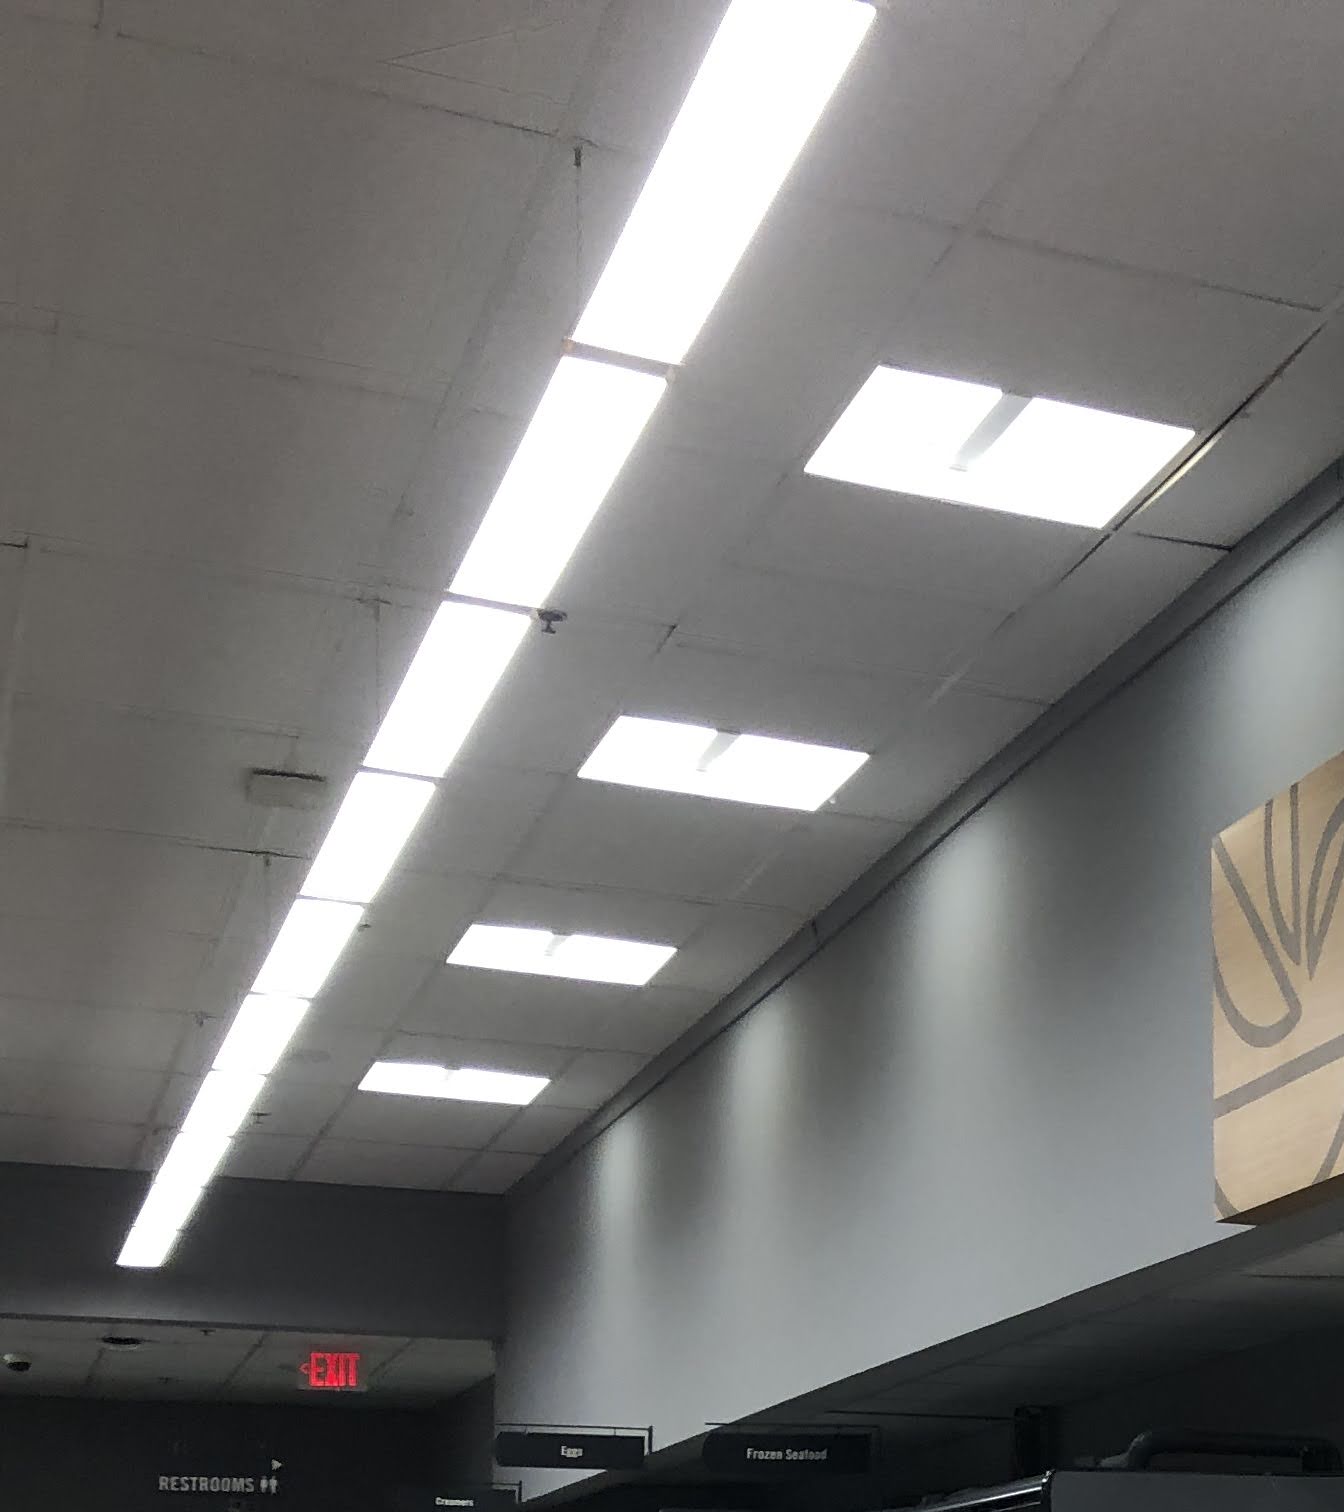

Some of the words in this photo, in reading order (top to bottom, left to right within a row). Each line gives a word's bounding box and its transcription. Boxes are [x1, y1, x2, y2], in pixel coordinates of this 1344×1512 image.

[310, 1352, 360, 1387] EXIT
[746, 1446, 783, 1460] Frozen
[785, 1448, 828, 1462] Seafood
[158, 1475, 255, 1493] RESTROOMS
